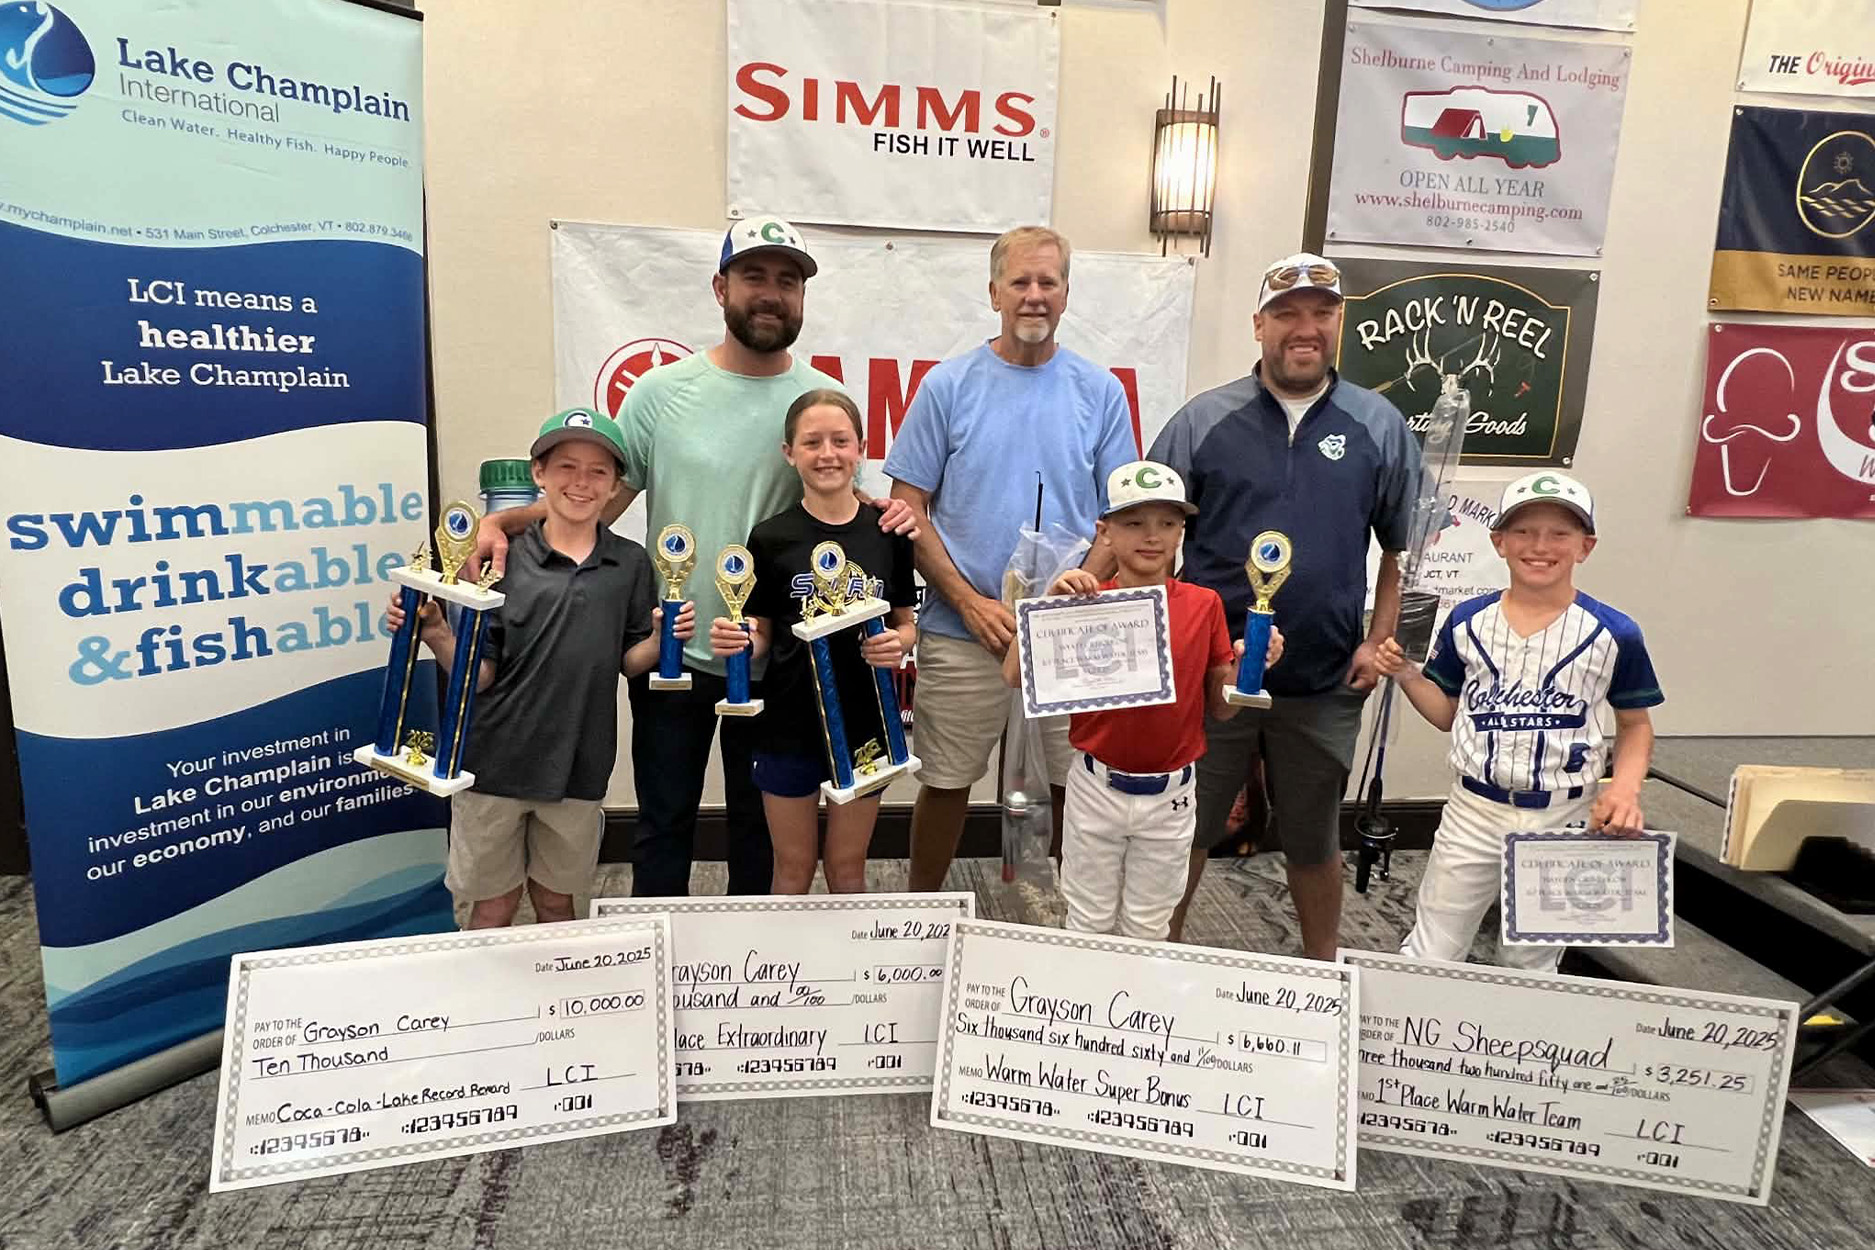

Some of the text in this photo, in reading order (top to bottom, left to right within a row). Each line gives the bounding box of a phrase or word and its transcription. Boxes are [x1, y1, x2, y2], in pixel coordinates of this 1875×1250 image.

[117, 37, 411, 122] Lake Champlain
[1351, 49, 1620, 90] Shelburne Camping And Lodging
[1769, 55, 1801, 74] THE
[1806, 51, 1875, 84] Origin
[120, 73, 279, 122] International
[733, 62, 1036, 138] SIMMS
[122, 110, 165, 128] Clean
[171, 118, 219, 137] Water.
[228, 128, 281, 149] Healthy
[286, 137, 316, 153] Fish.
[324, 144, 366, 162] Happy
[874, 133, 1035, 162] FISH IT WELL
[1400, 171, 1545, 198] OPEN ALL YEAR
[1355, 193, 1583, 223] www.shelburnecamping.com
[145, 226, 169, 239] 531
[174, 228, 204, 240] Main
[208, 228, 248, 240] Street,
[318, 221, 333, 232] VT
[761, 222, 785, 243] C
[1426, 216, 1515, 233] 802-985-2540
[1778, 264, 1819, 279] SAME
[128, 279, 318, 313] LCI means a
[1787, 287, 1823, 301] NEW
[138, 320, 315, 353] healthier
[1357, 296, 1552, 359] RACK 'N REEL
[101, 361, 350, 392] Lake Champlain
[1465, 412, 1527, 436] Goods
[1136, 467, 1162, 488] C
[1531, 476, 1561, 494] C
[7, 483, 423, 550] swimmable
[1459, 497, 1500, 527] MARK
[1423, 552, 1473, 564] AURANT
[59, 544, 405, 618] drinkable
[1424, 570, 1459, 579] JCT, VT
[1466, 679, 1588, 711] Colchester
[1512, 717, 1552, 727] STARS
[167, 727, 350, 779] Your investment in
[135, 752, 352, 815] Lake Champlain is
[88, 769, 388, 853] investment in our environm
[87, 861, 126, 881] our
[133, 824, 252, 868] economy,
[259, 810, 294, 833] and
[301, 805, 330, 822] our
[851, 921, 898, 939] Date June
[535, 956, 590, 973] Date June
[673, 962, 731, 991] rayson
[744, 949, 801, 993] Carey
[674, 986, 780, 1009] ousand and
[966, 983, 1005, 996] PAY TO THE
[1216, 988, 1233, 1000] Date
[1236, 982, 1270, 1006] June
[965, 999, 1000, 1011] ORDER OF
[1010, 976, 1175, 1053] Grayson Carey
[254, 1018, 301, 1033] PAY TO THE
[304, 1013, 450, 1043] Grayson Carey
[538, 1028, 575, 1042] DOLLARS
[1374, 1016, 1399, 1028] TO THE
[1384, 1031, 1394, 1041] OF
[1636, 1023, 1656, 1034] Date
[1658, 1017, 1695, 1041] June
[252, 1034, 297, 1049] ORDER OF
[675, 1023, 898, 1055] lace Extraordinary LCI
[956, 1013, 979, 1034] Six
[1049, 1030, 1069, 1046] six
[1074, 1033, 1125, 1056] hundred
[1132, 1045, 1168, 1067] sixty
[1171, 1052, 1190, 1065] and
[1403, 1016, 1613, 1074] NG Sheepsquad
[252, 1047, 388, 1076] Ten Thousand
[1391, 1047, 1592, 1094] thousand two hundred fifty one
[959, 1054, 1264, 1119] MEMO Warm Water Super Bonus LCI
[1657, 1066, 1746, 1091] 3,251.25
[246, 1110, 275, 1125] MEMO
[422, 1084, 465, 1102] Record
[547, 1065, 598, 1086] LCI
[1401, 1085, 1440, 1110] Place
[1447, 1089, 1490, 1119] Warm
[1494, 1092, 1538, 1124] Water
[1543, 1101, 1582, 1130] Team
[1636, 1119, 1685, 1145] LCI
